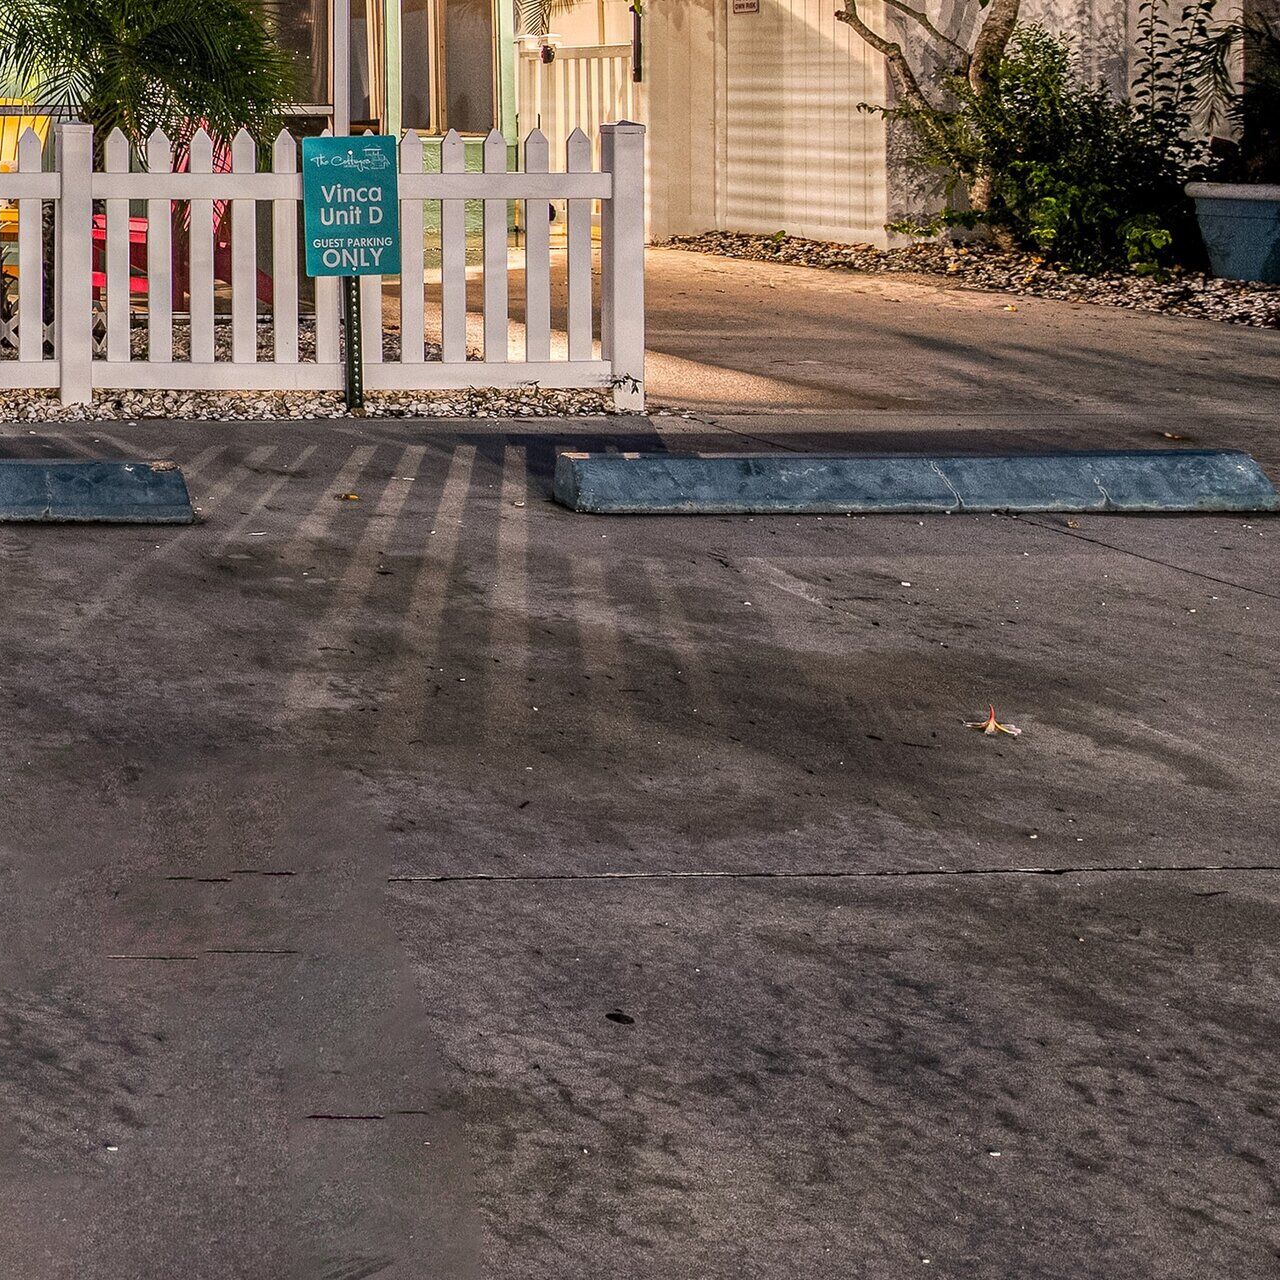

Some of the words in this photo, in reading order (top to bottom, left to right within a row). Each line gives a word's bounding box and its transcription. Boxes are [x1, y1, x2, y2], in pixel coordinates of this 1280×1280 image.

[311, 154, 328, 167] The
[321, 184, 382, 202] Vinca
[321, 206, 361, 225] Unit
[369, 207, 383, 224] D
[313, 238, 344, 248] GUEST
[348, 238, 392, 246] PARKING
[323, 248, 383, 267] ONLY
